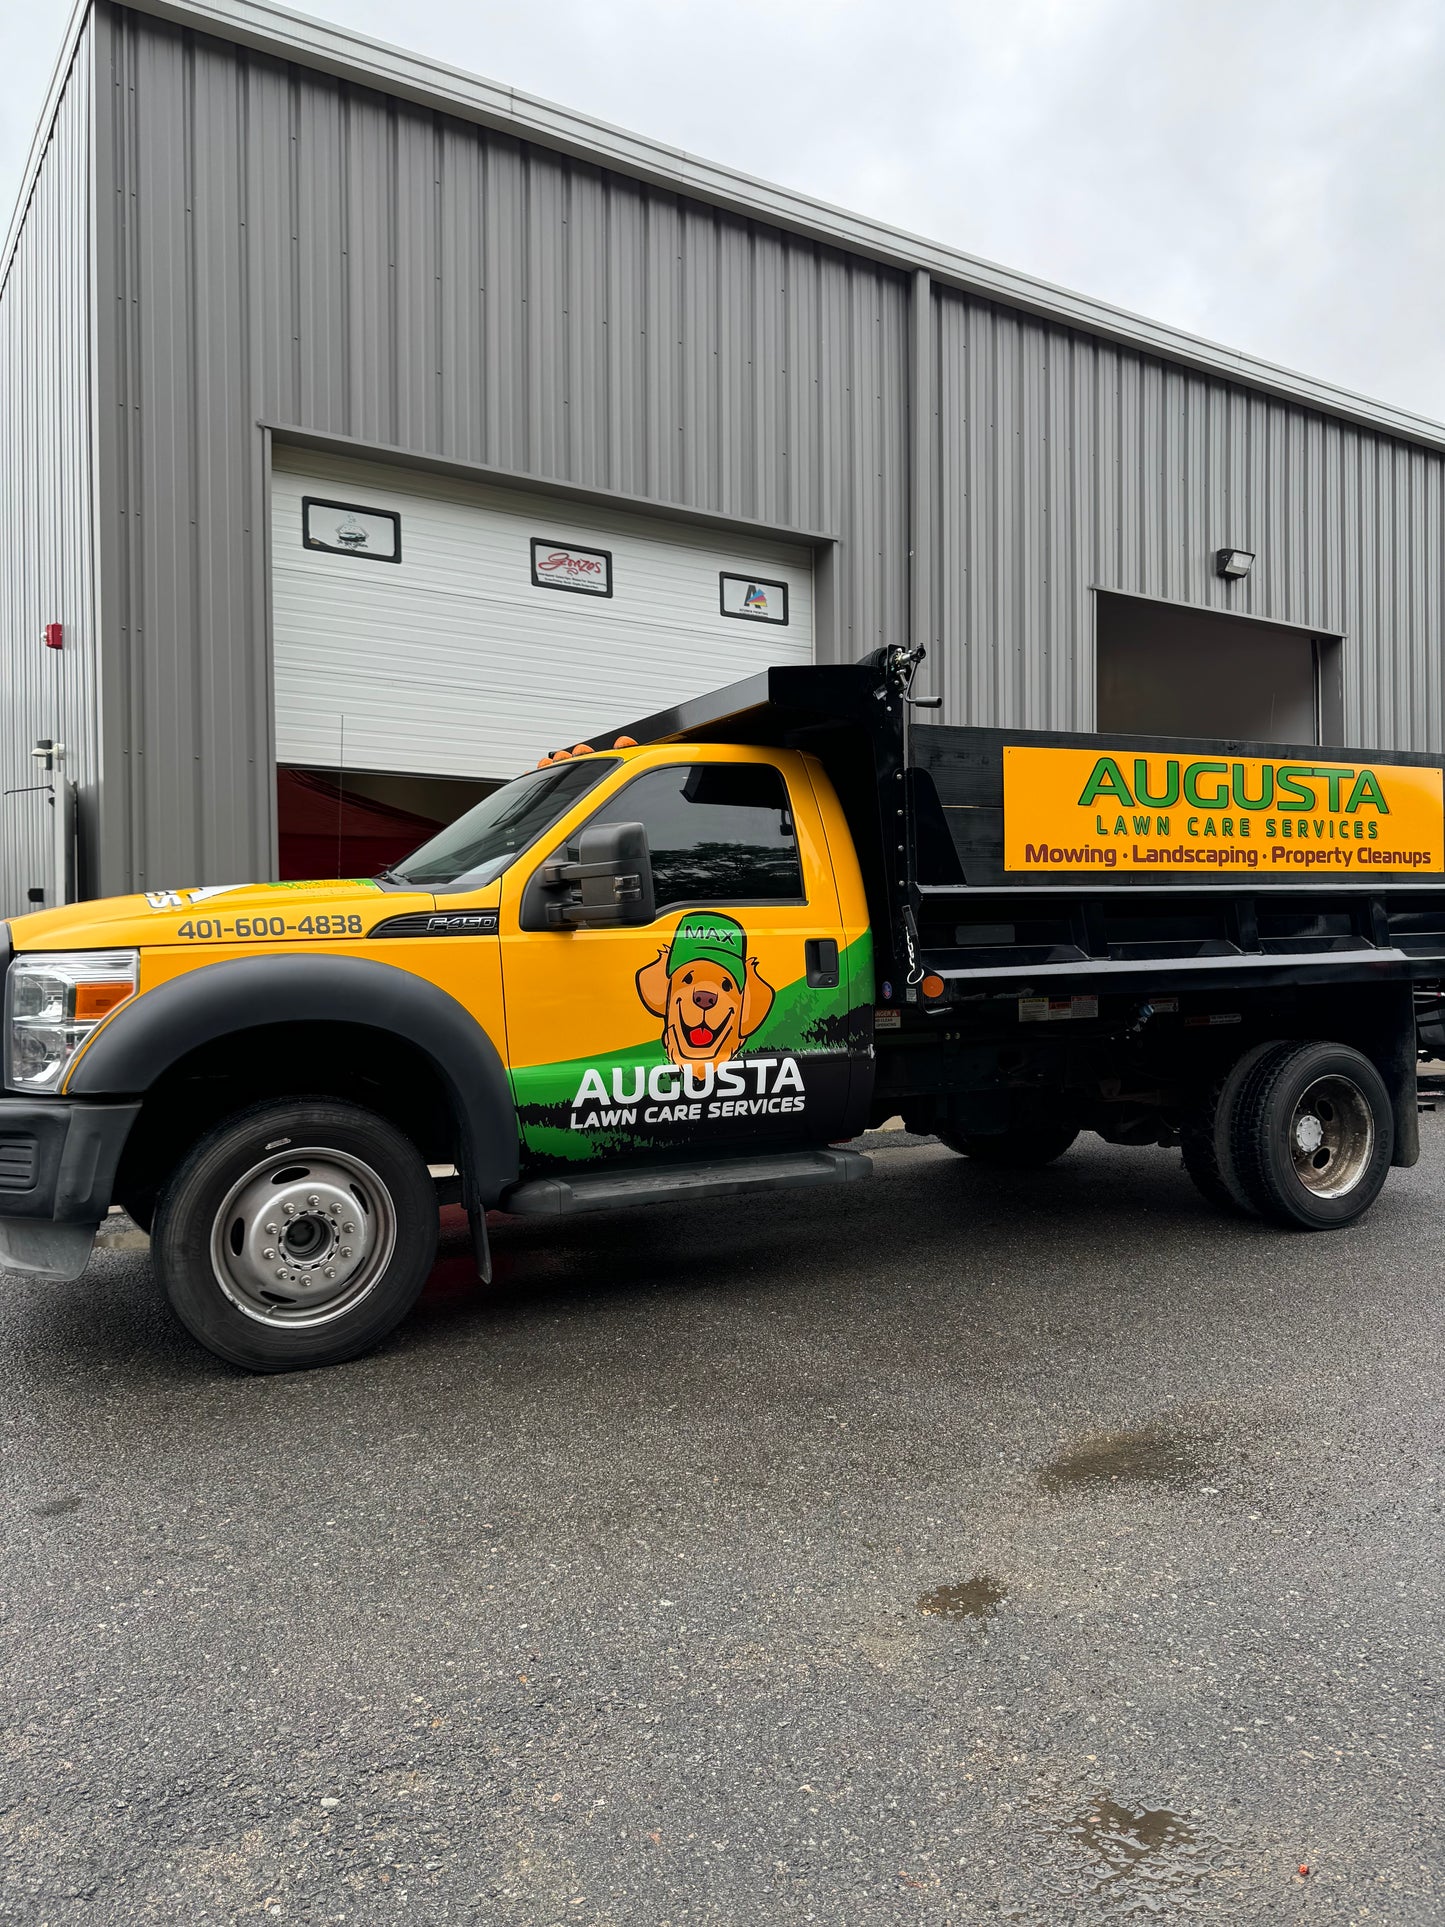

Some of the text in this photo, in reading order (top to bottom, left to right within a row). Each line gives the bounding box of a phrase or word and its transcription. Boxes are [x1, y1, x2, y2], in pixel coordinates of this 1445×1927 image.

[1077, 757, 1391, 815] AUGUSTA
[1096, 814, 1379, 839] LAWN CARE SERVICES
[1025, 843, 1432, 867] Mowing Landscaping Property Cleanups
[177, 914, 363, 940] 401-600-4838
[426, 916, 497, 931] F-450
[684, 925, 736, 946] MAX
[571, 1057, 806, 1108] AUGUSTA
[570, 1095, 806, 1129] LAWN CARE SERVICES
